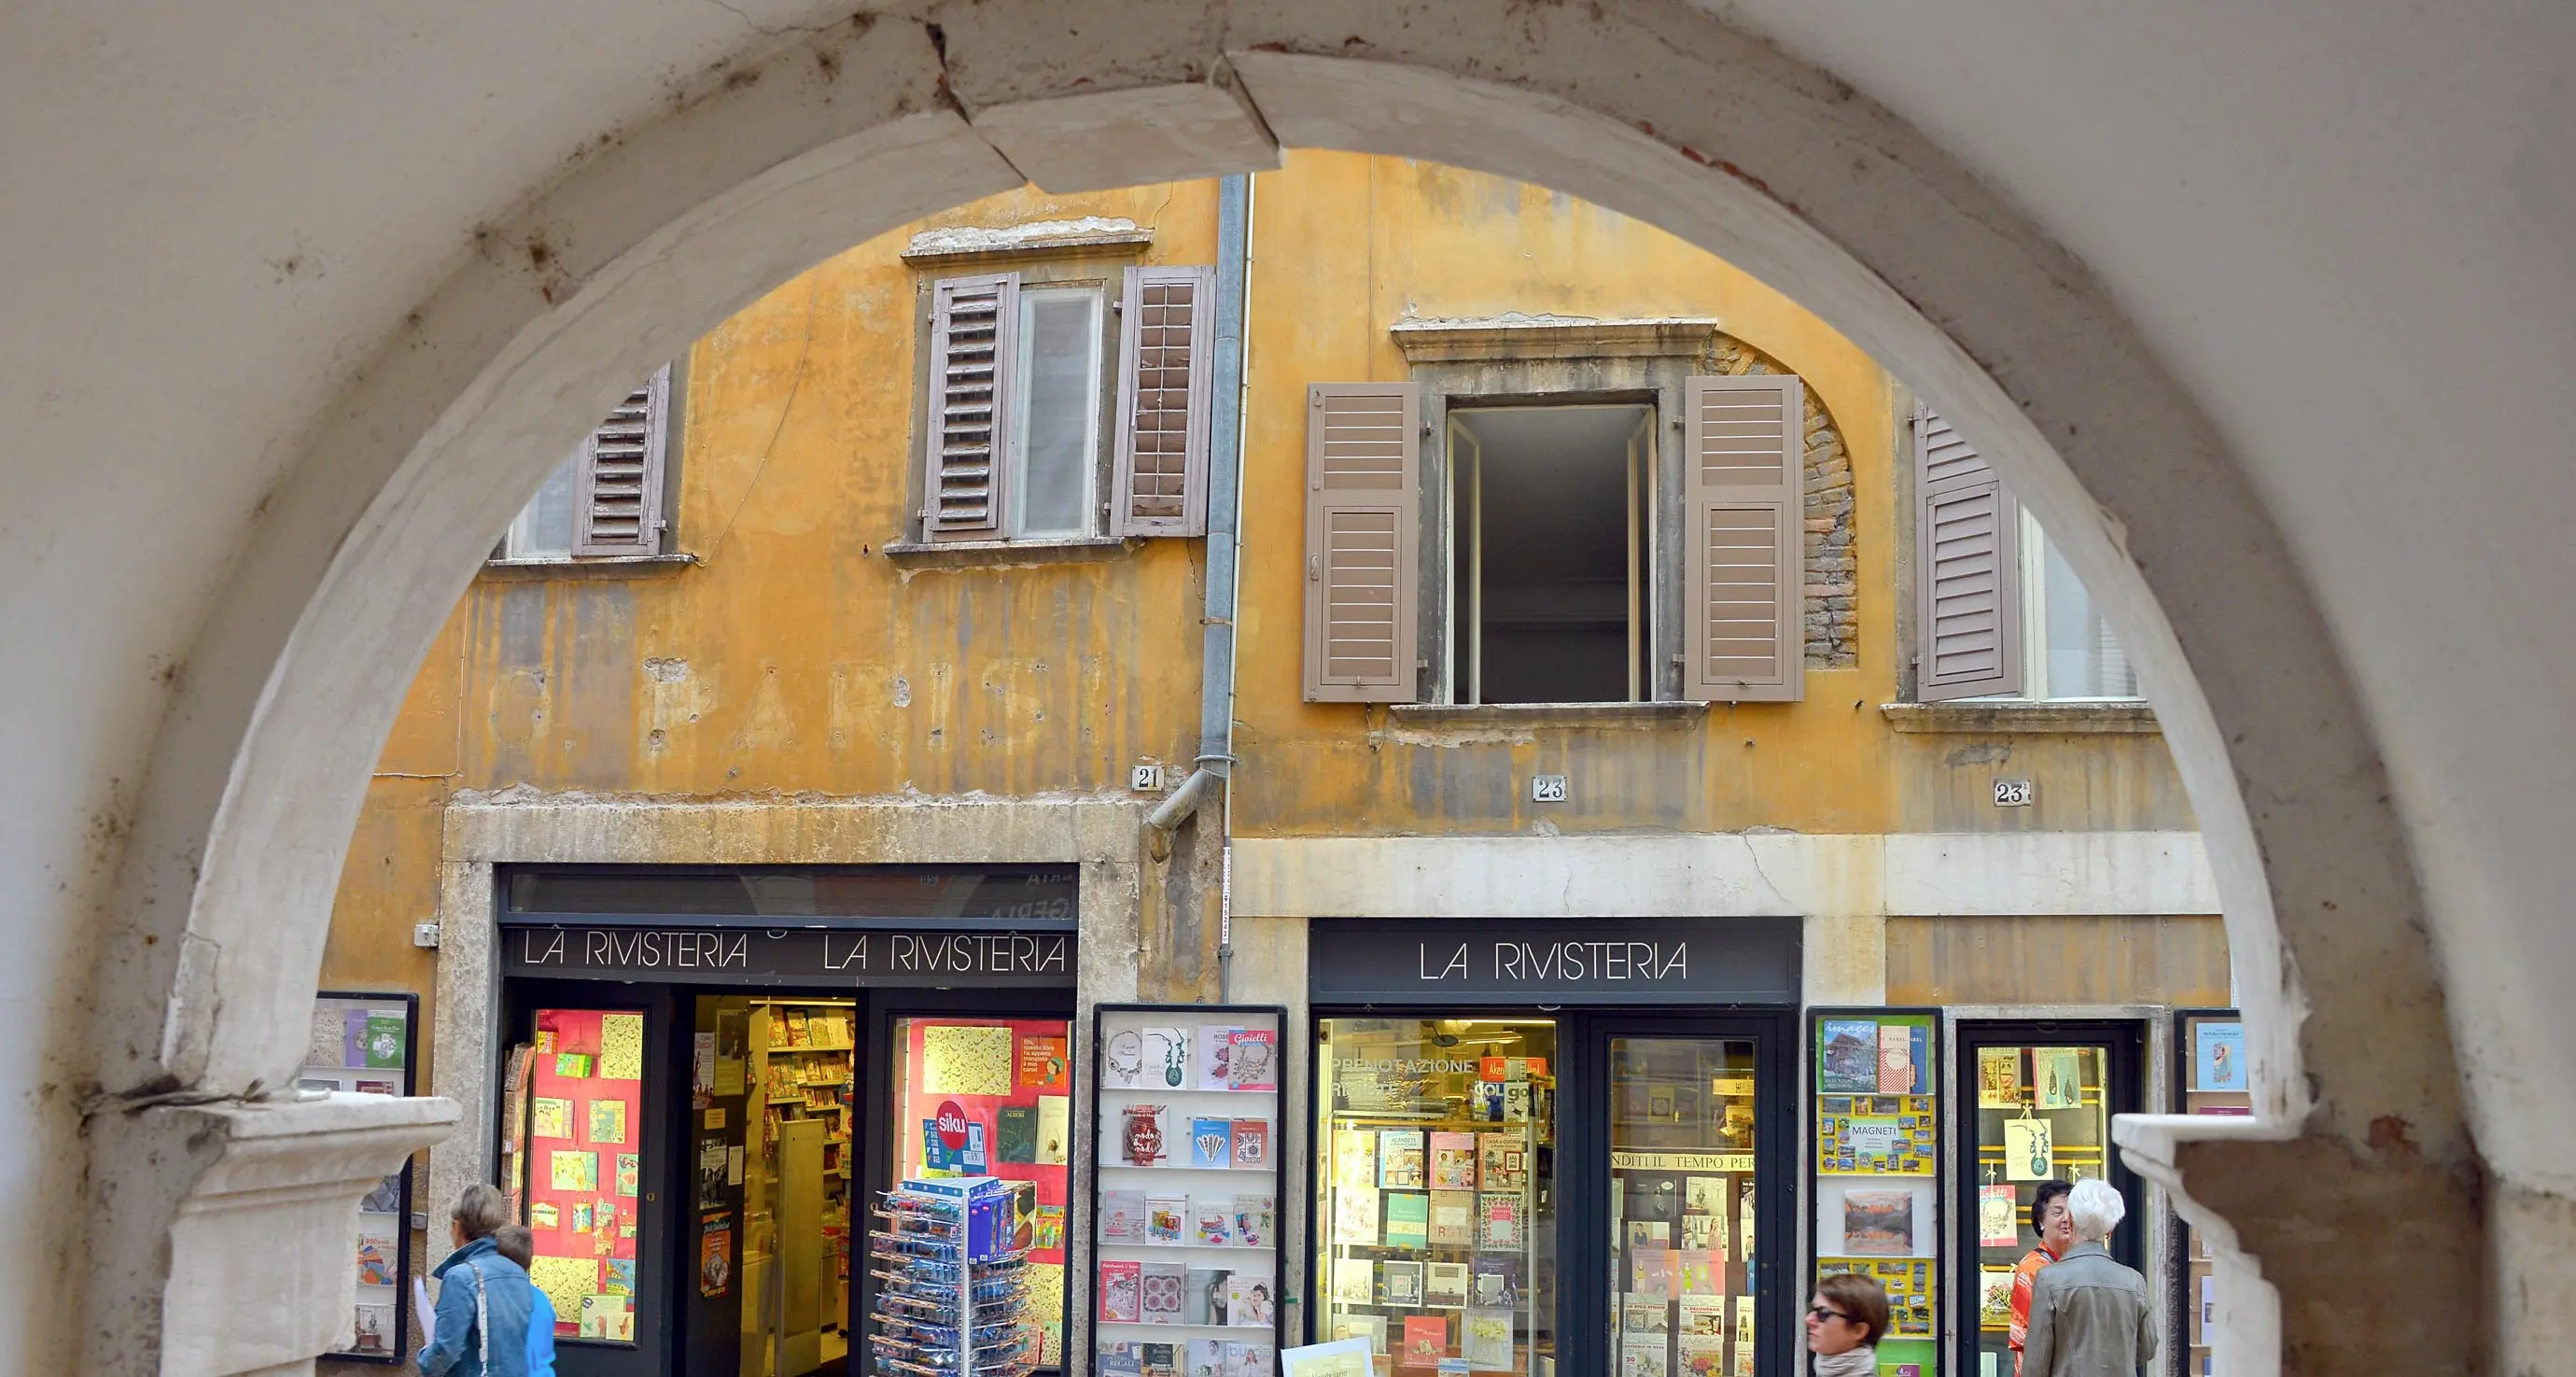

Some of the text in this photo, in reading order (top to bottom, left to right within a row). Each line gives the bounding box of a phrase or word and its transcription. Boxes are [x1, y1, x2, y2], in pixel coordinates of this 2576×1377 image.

[1139, 768, 1158, 788] 21
[1539, 779, 1562, 797] 23
[525, 931, 748, 967] LA RIVISTERIA
[824, 934, 1065, 972] LA RIVISTERIA
[1421, 942, 1687, 980] LA RIVISTERIA
[1825, 1022, 1875, 1036] images
[1332, 1059, 1473, 1074] PRENOTAZIONE
[939, 1113, 965, 1133] siku
[1853, 1126, 1897, 1135] MAGNETI
[1651, 1157, 1666, 1167] IL
[1674, 1157, 1724, 1168] TEMPO
